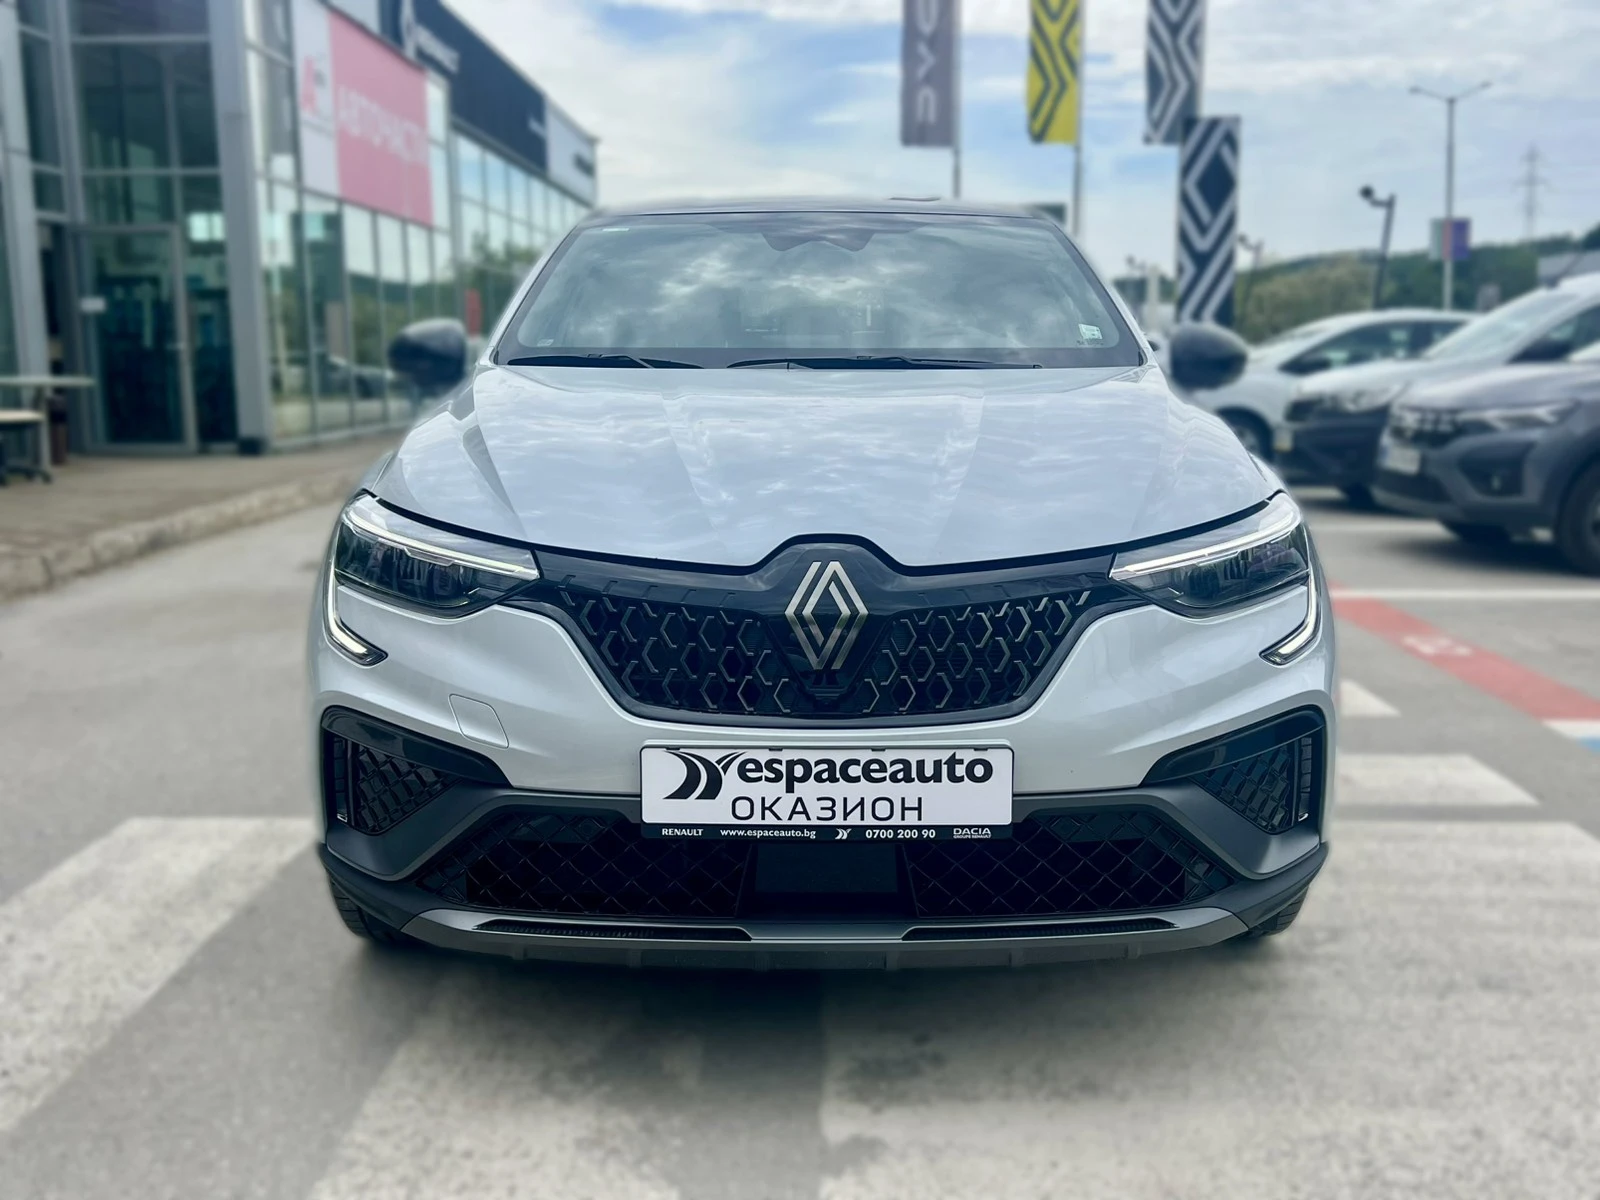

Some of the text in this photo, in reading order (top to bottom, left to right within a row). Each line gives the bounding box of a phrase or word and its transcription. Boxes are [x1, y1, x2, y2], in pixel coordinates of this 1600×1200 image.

[736, 751, 993, 794] espaceauto
[731, 796, 923, 821] ОКАЗИОН
[661, 828, 704, 836] RENAULT
[720, 828, 817, 839] www.espaceauto.bg
[865, 829, 936, 839] 0700 200 90
[953, 827, 991, 835] DACIA
